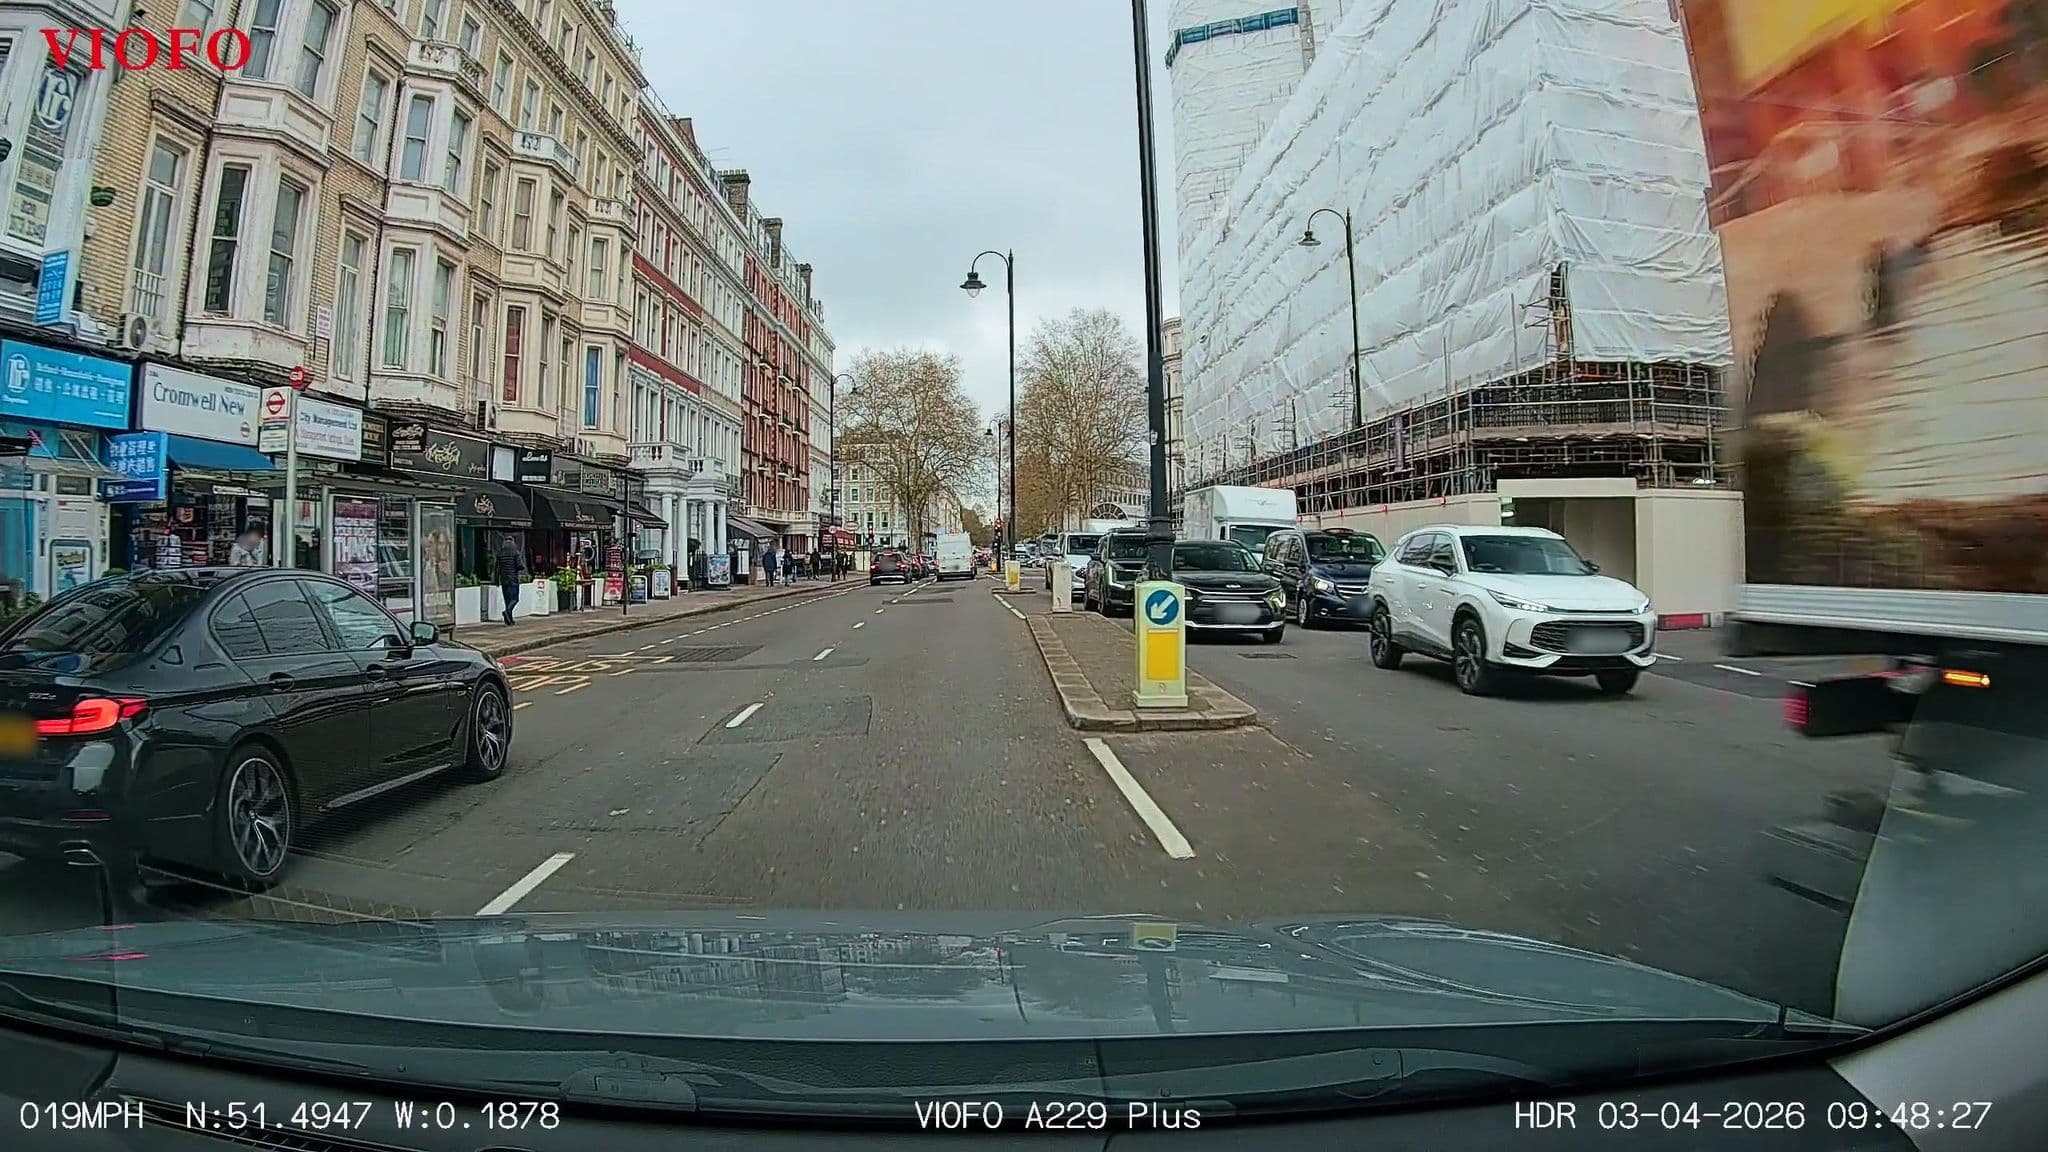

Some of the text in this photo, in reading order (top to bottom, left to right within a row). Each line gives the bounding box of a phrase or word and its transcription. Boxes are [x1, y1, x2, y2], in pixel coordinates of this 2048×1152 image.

[153, 381, 217, 411] Cromwell
[218, 395, 245, 416] New
[505, 659, 629, 672] BUS
